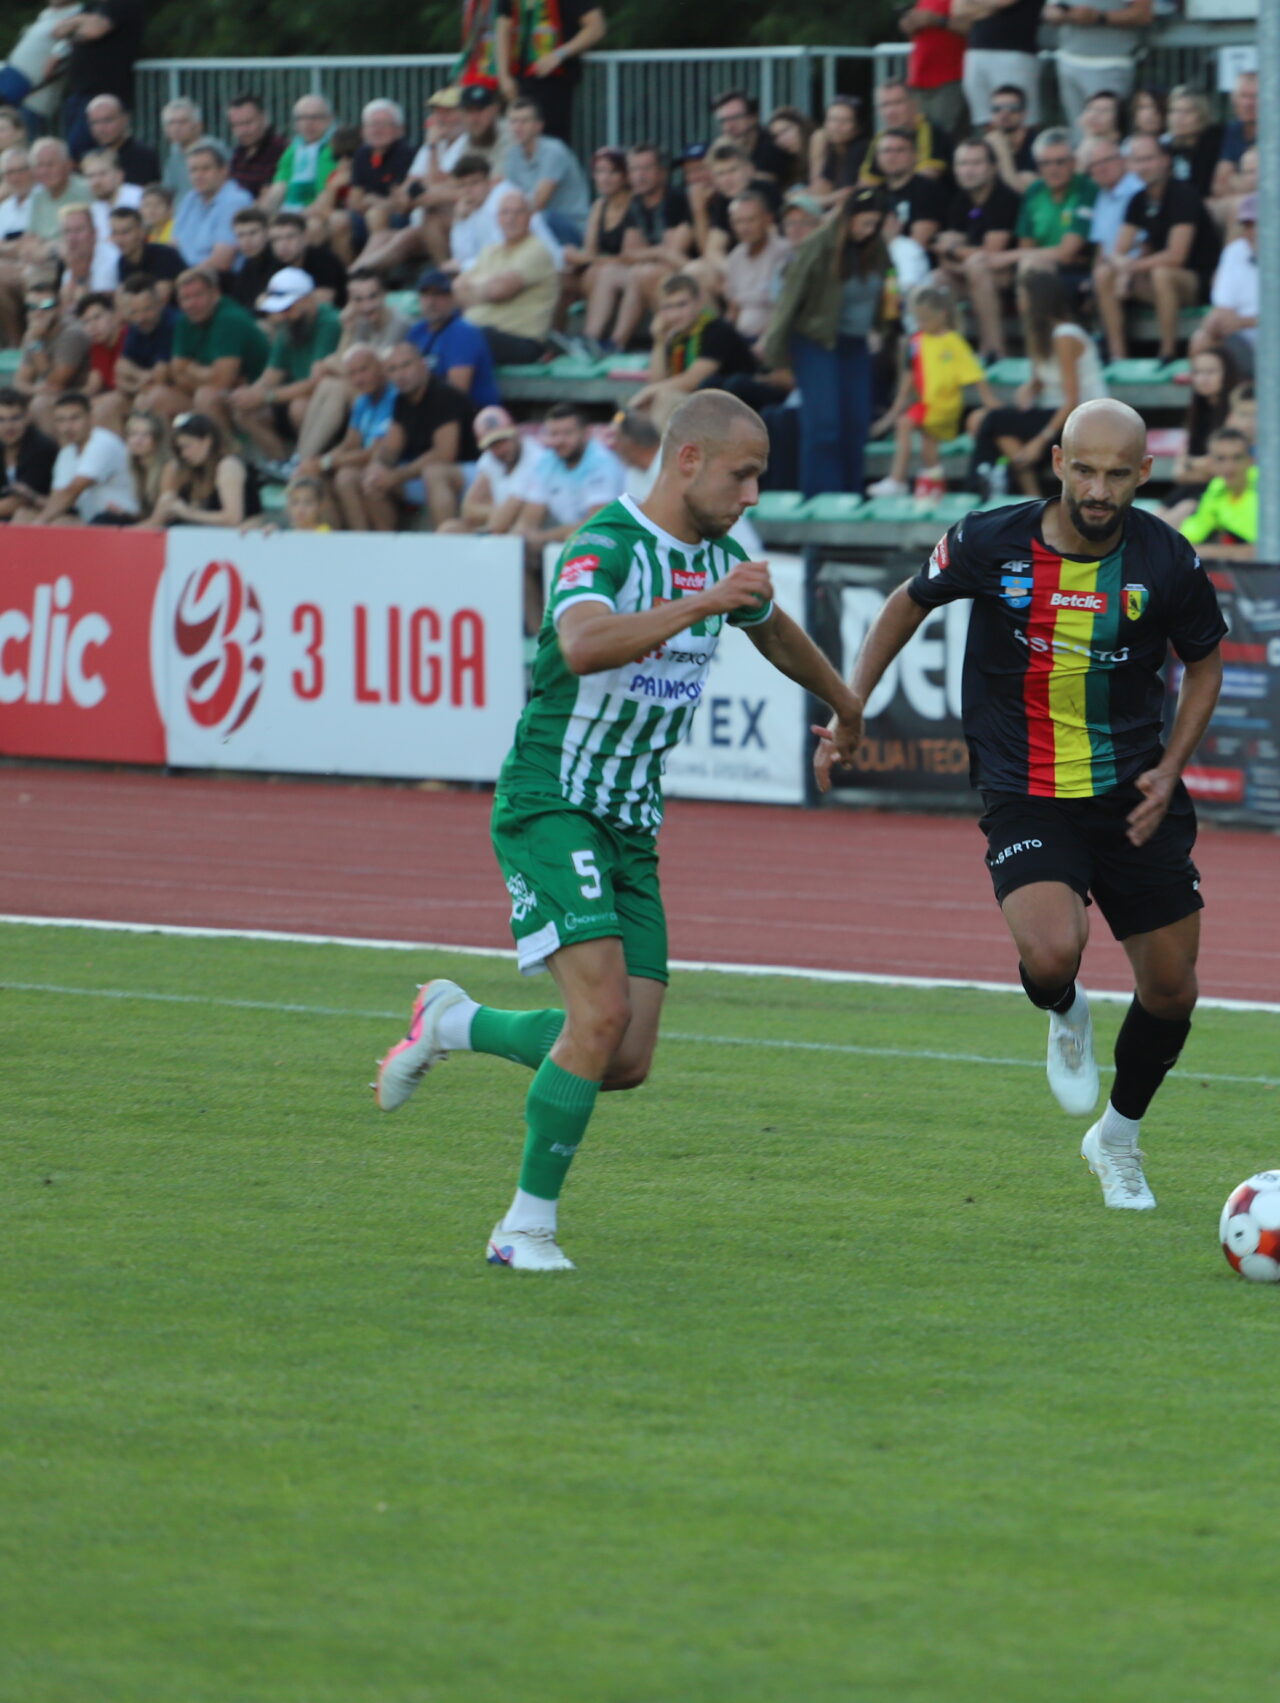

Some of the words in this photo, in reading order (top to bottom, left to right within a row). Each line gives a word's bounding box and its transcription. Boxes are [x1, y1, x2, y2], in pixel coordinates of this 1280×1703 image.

[1050, 593, 1102, 609] Betclic
[0, 575, 111, 708] clic
[291, 603, 325, 701] 3
[353, 603, 487, 708] LIGA
[711, 696, 767, 749] EX
[571, 850, 602, 899] 5
